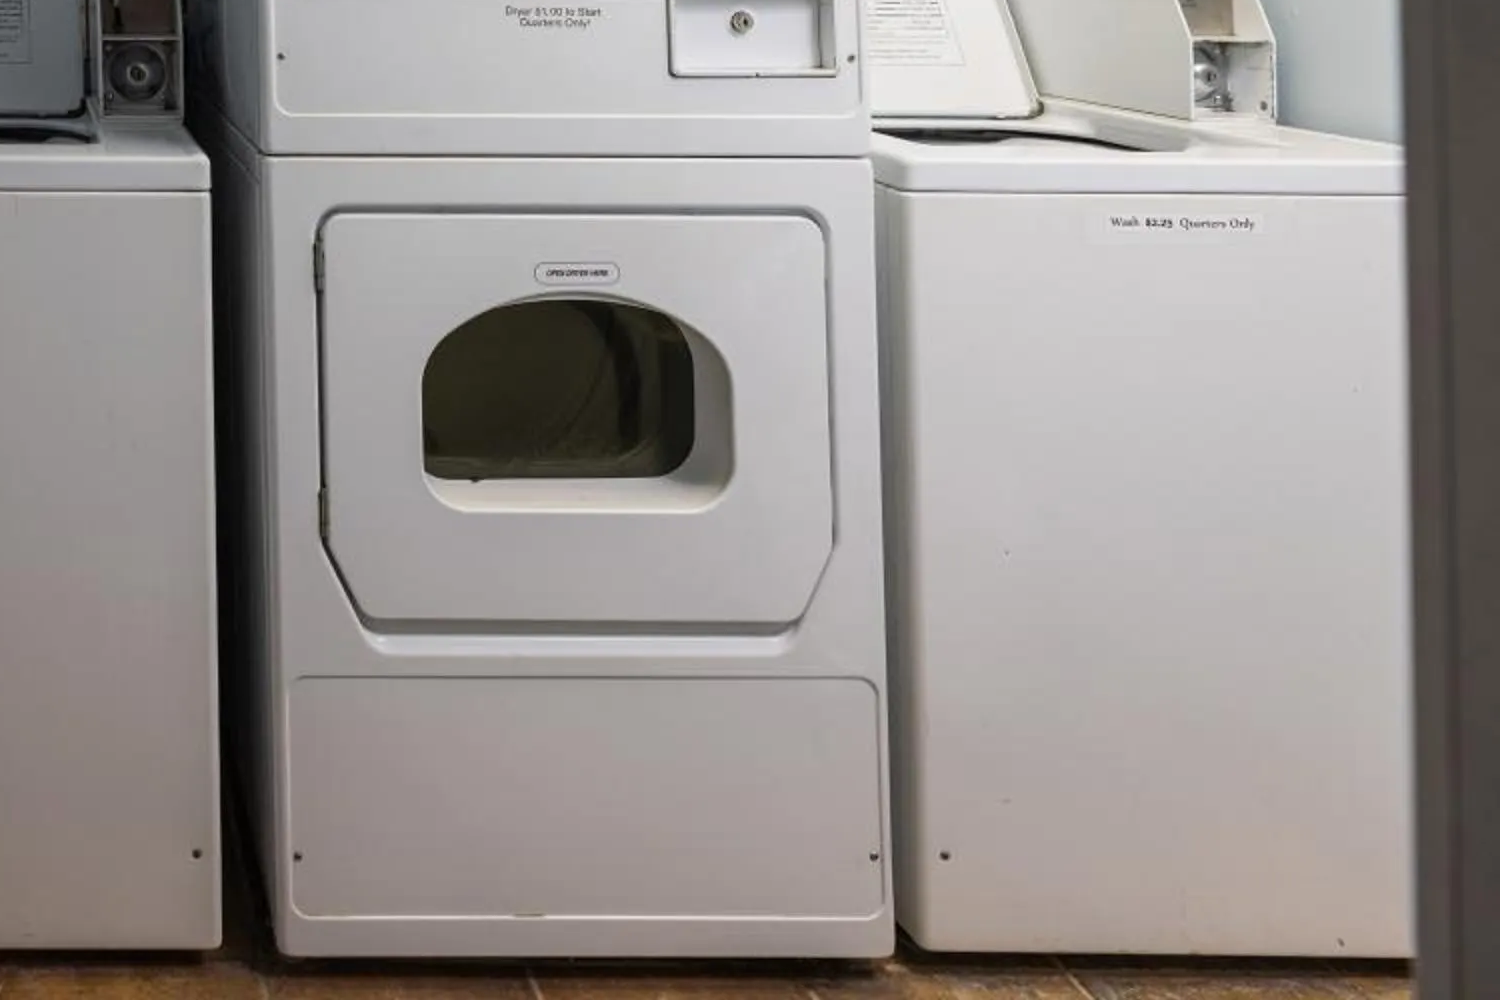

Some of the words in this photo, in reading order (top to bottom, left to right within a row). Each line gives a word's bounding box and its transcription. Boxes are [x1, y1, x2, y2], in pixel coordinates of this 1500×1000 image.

[505, 5, 533, 18] Dryer
[578, 7, 601, 17] Start
[1110, 216, 1140, 227] Wash
[1179, 216, 1226, 230] Quarters
[1229, 216, 1255, 231] Only
